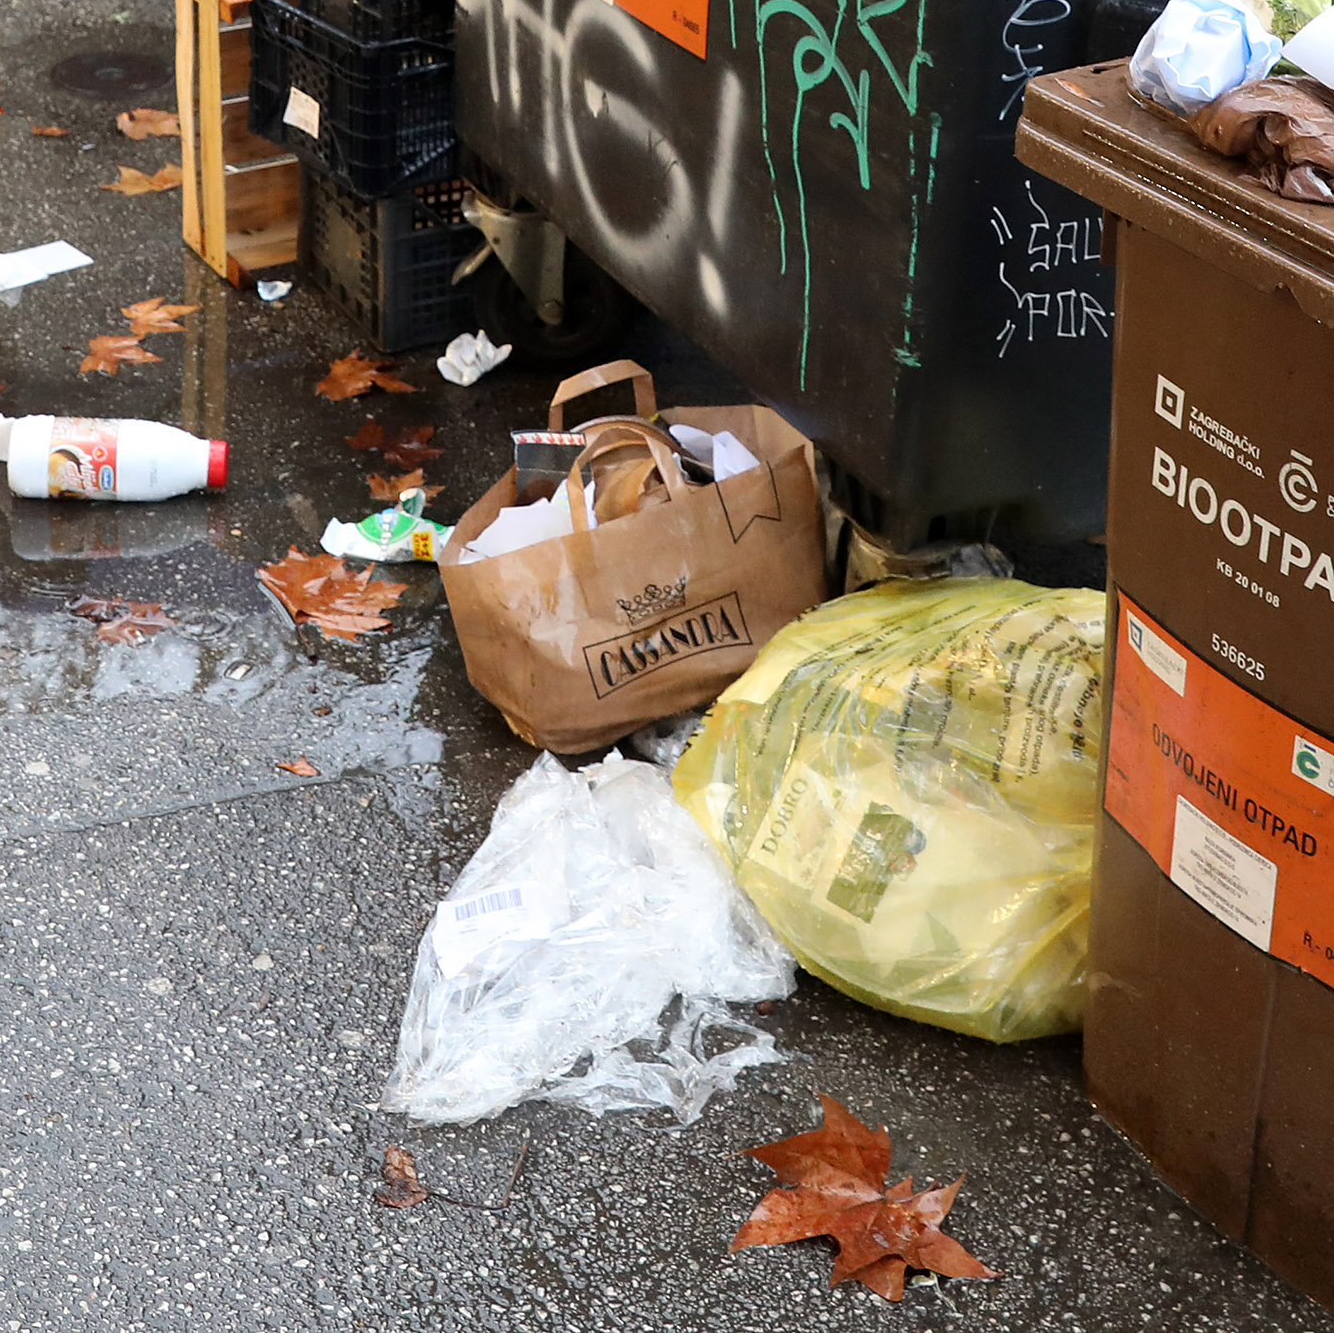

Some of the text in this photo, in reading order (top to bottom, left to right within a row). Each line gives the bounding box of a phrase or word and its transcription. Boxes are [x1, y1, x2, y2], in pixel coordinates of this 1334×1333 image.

[1188, 420, 1266, 479] HOLDING d.o.o.
[1189, 405, 1261, 460] ZAGREBAČKI
[1216, 558, 1233, 578] KB
[1235, 571, 1249, 589] 20
[1251, 581, 1264, 599] 01
[601, 605, 740, 687] CASSANDRA
[1211, 633, 1266, 681] 536625
[760, 777, 808, 856] DOBRO
[1152, 722, 1317, 857] ODVOJENI OTPAD
